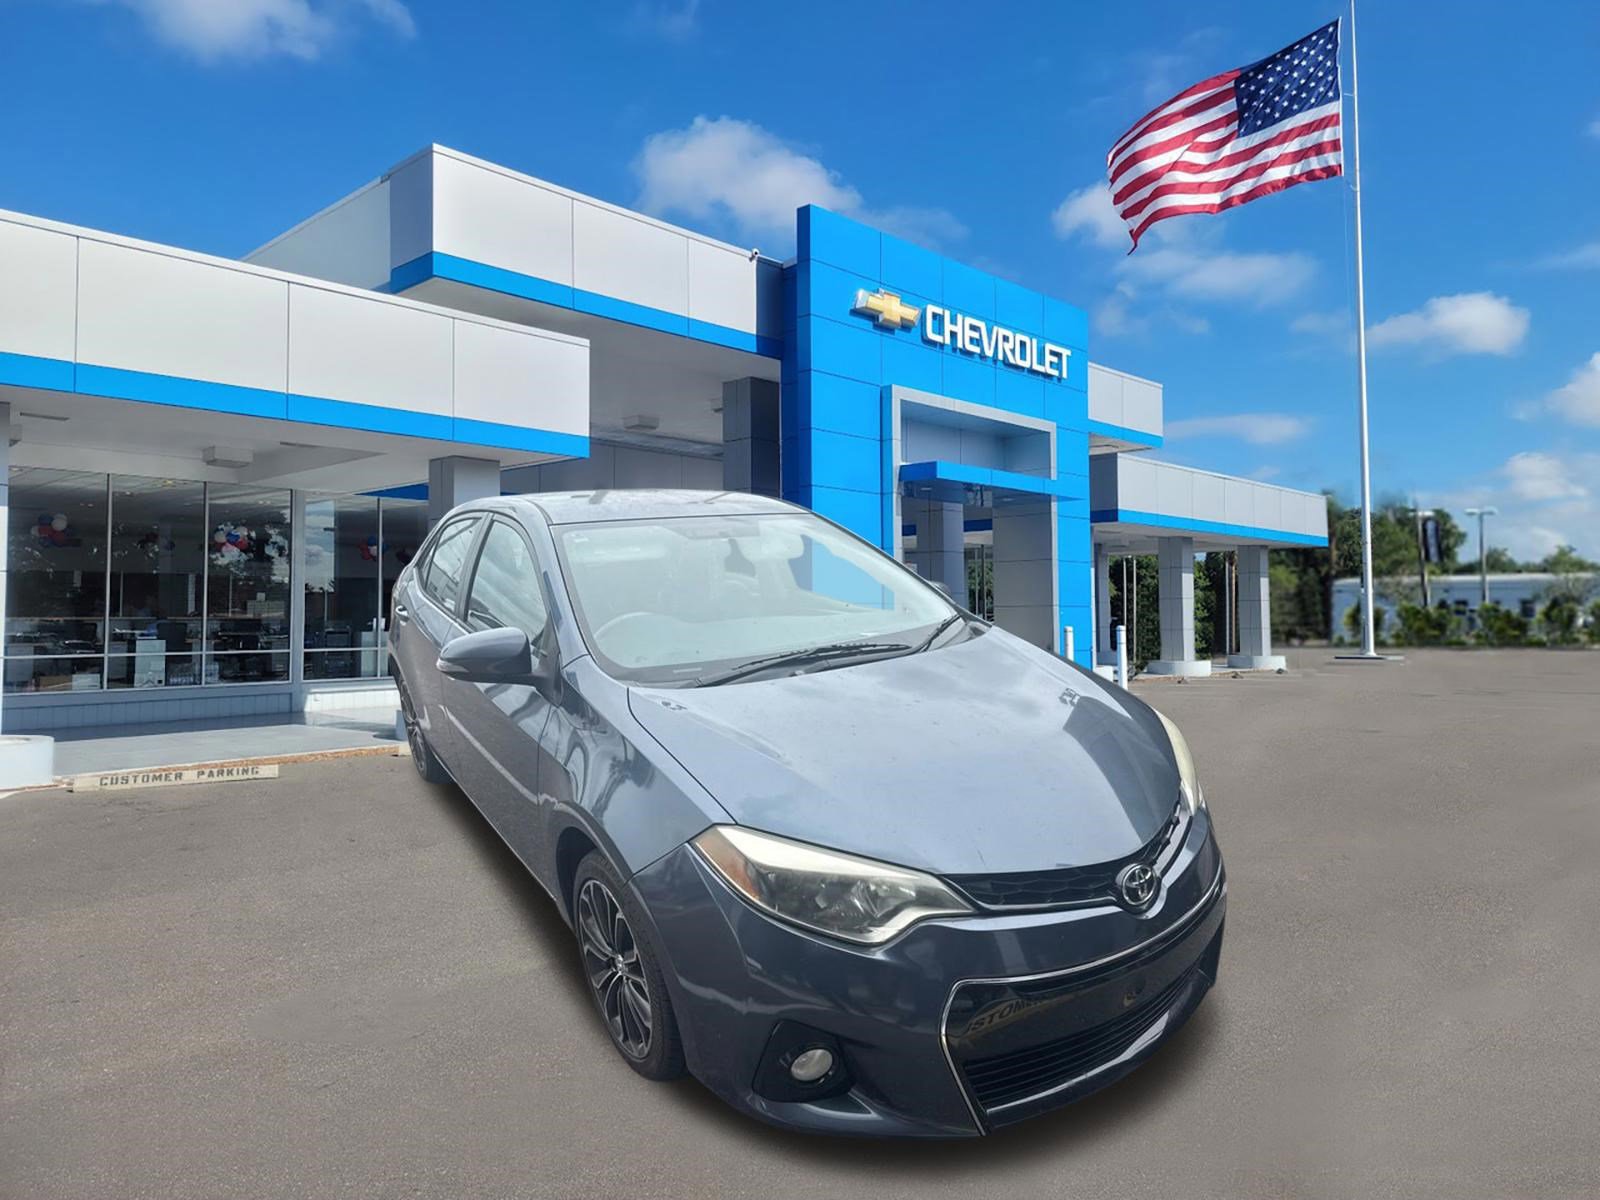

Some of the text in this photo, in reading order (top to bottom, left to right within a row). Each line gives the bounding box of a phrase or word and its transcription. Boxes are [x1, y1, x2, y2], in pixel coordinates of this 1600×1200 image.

[925, 303, 1072, 379] CHEVROLET
[99, 766, 259, 786] CUSTOMER PARKING
